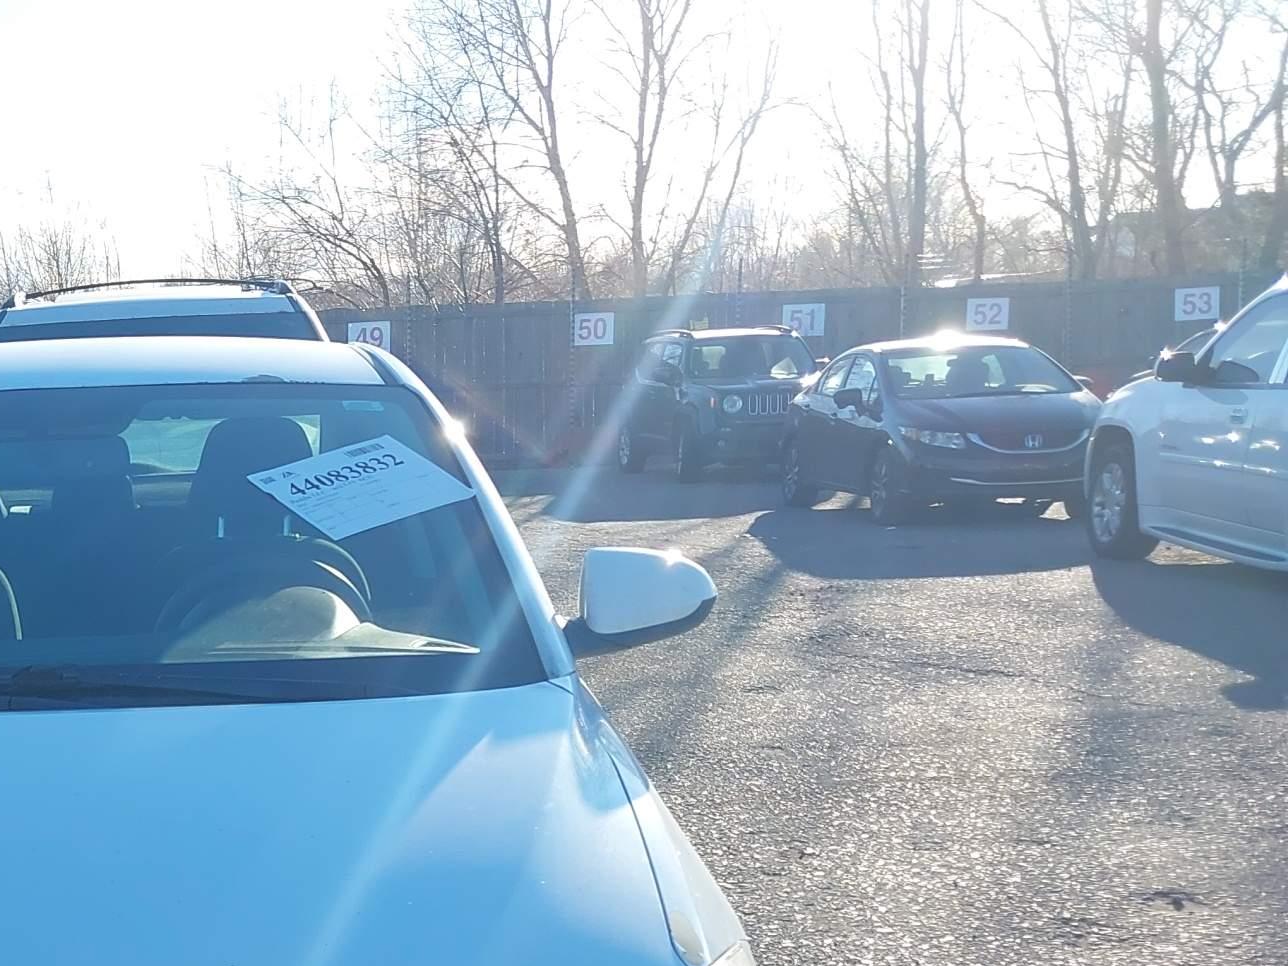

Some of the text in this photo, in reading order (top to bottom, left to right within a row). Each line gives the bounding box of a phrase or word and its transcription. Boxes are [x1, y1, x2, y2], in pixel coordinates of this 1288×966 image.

[973, 302, 1002, 325] 52
[1182, 292, 1212, 315] 53
[578, 317, 607, 340] 50
[790, 308, 815, 333] 51
[355, 326, 384, 347] 49
[289, 453, 405, 498] 44083832
